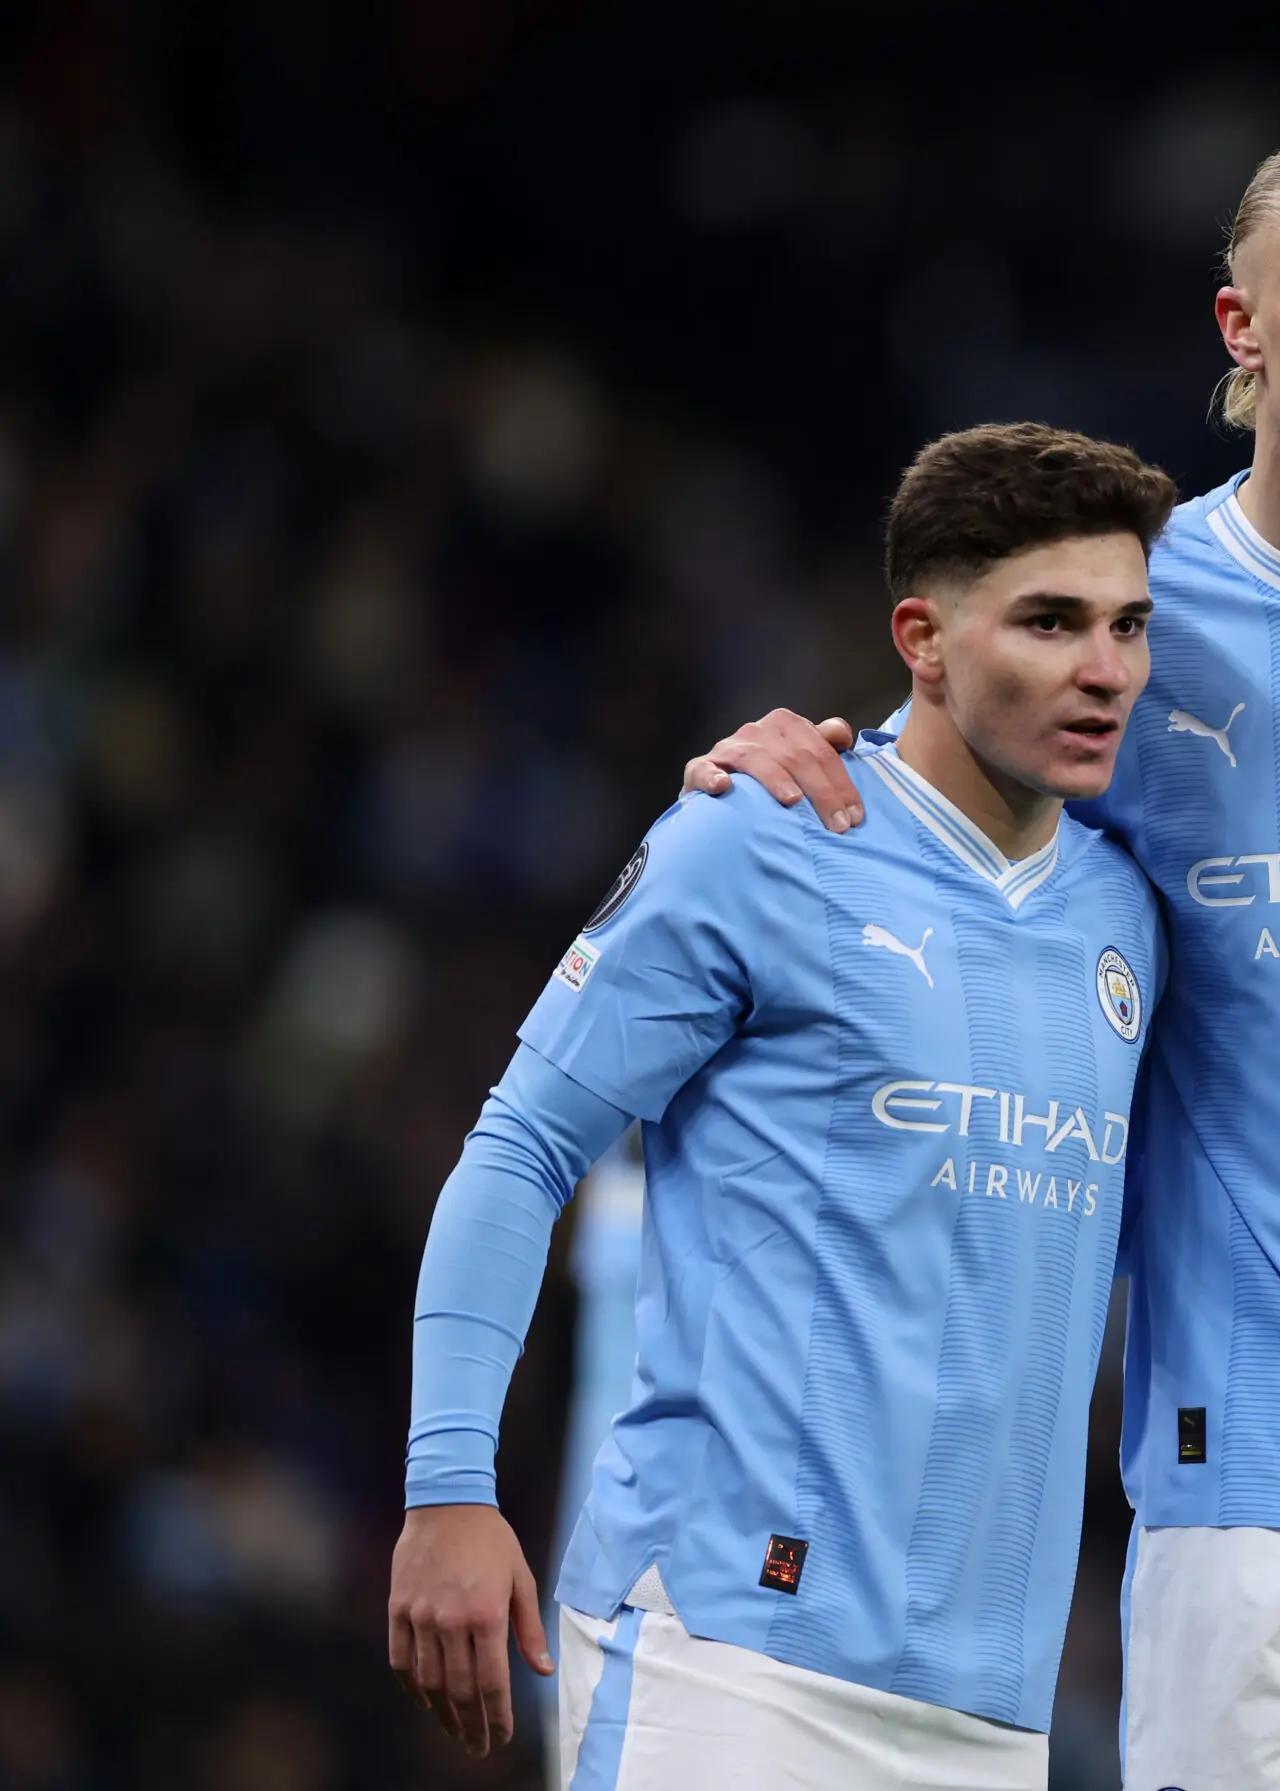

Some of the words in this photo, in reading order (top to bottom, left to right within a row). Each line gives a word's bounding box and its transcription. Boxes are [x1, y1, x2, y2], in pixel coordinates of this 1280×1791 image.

[1120, 1026, 1133, 1037] CITY
[871, 1081, 1129, 1165] ETIHAD
[930, 1158, 1099, 1216] AIRWAYS
